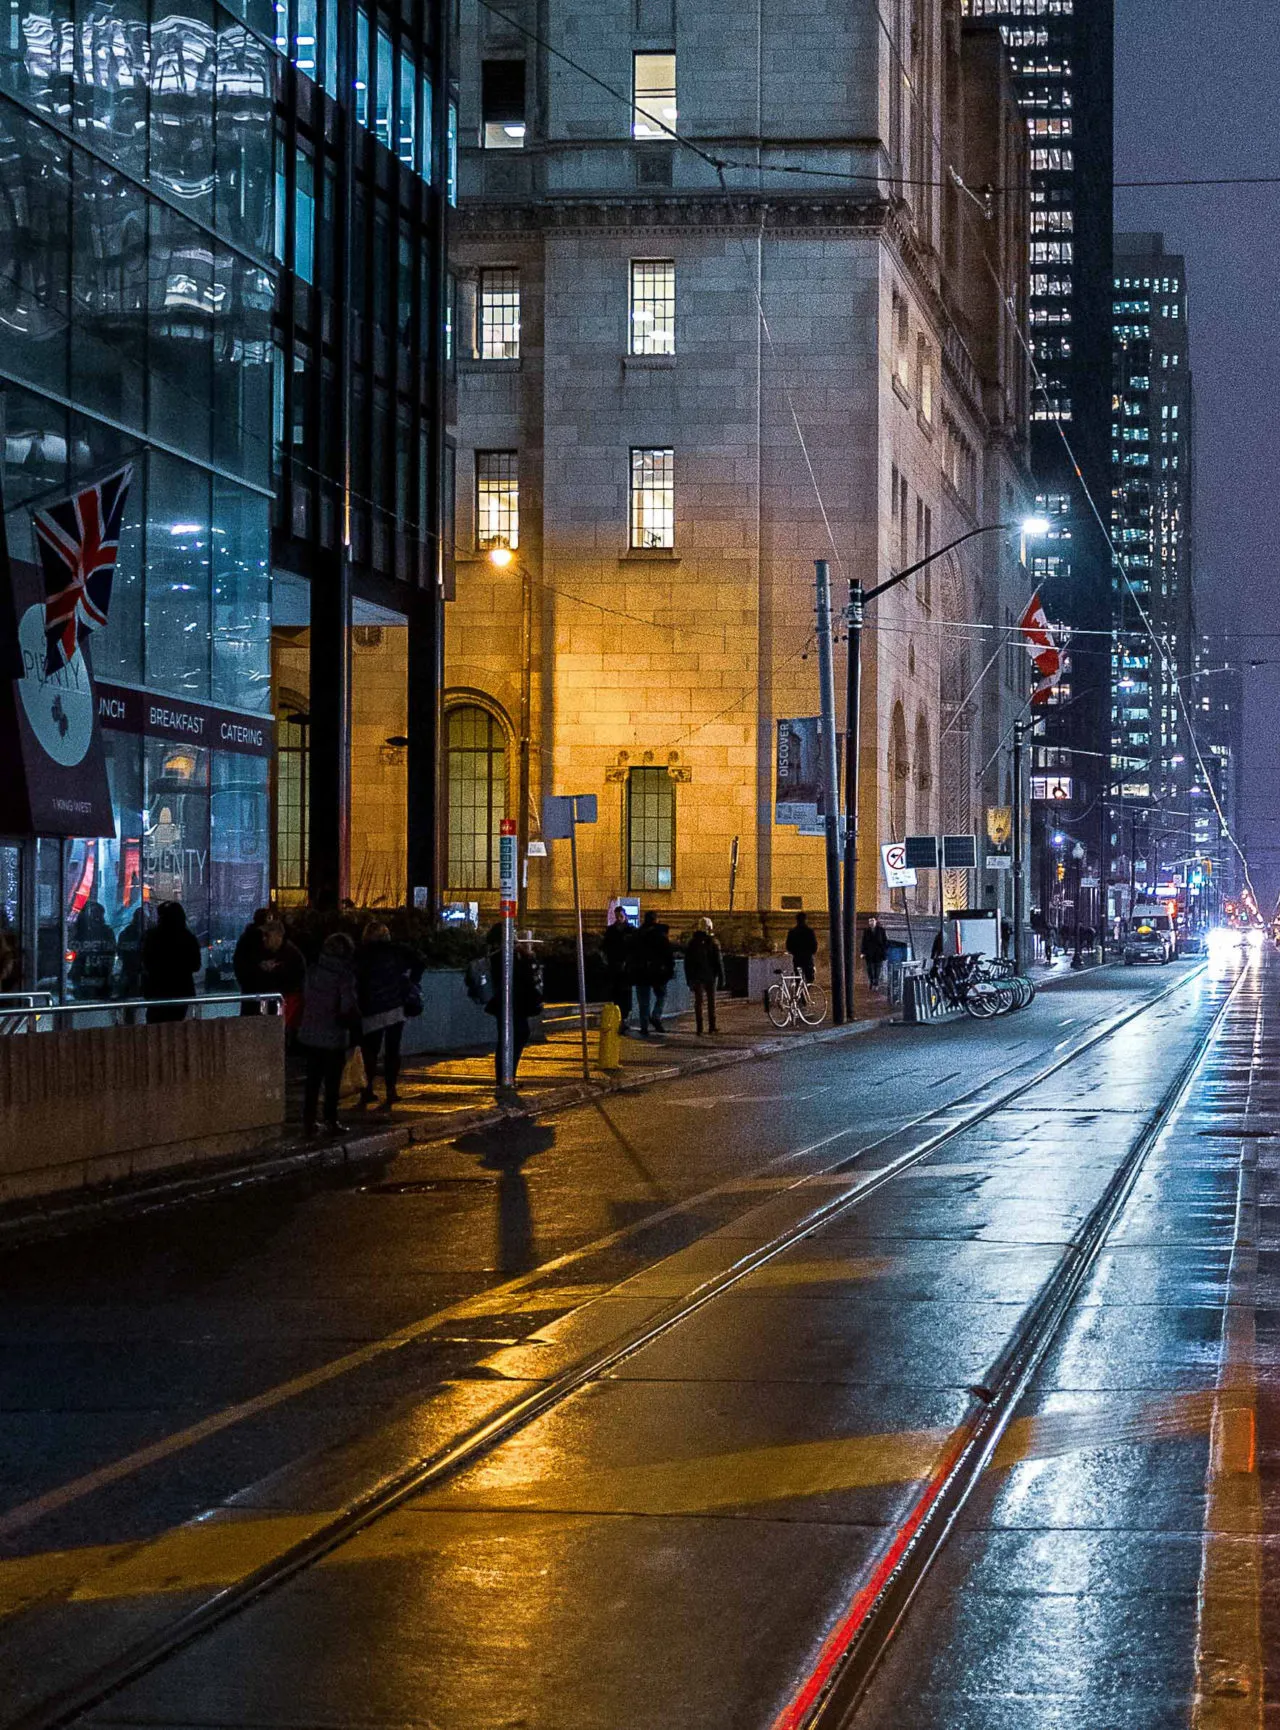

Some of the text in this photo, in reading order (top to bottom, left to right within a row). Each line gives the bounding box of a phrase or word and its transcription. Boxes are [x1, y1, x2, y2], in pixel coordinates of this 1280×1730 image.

[150, 706, 205, 735] BREAKFAST
[220, 722, 263, 747] CATERING
[779, 723, 789, 777] DISCOVER
[74, 801, 92, 813] WEST
